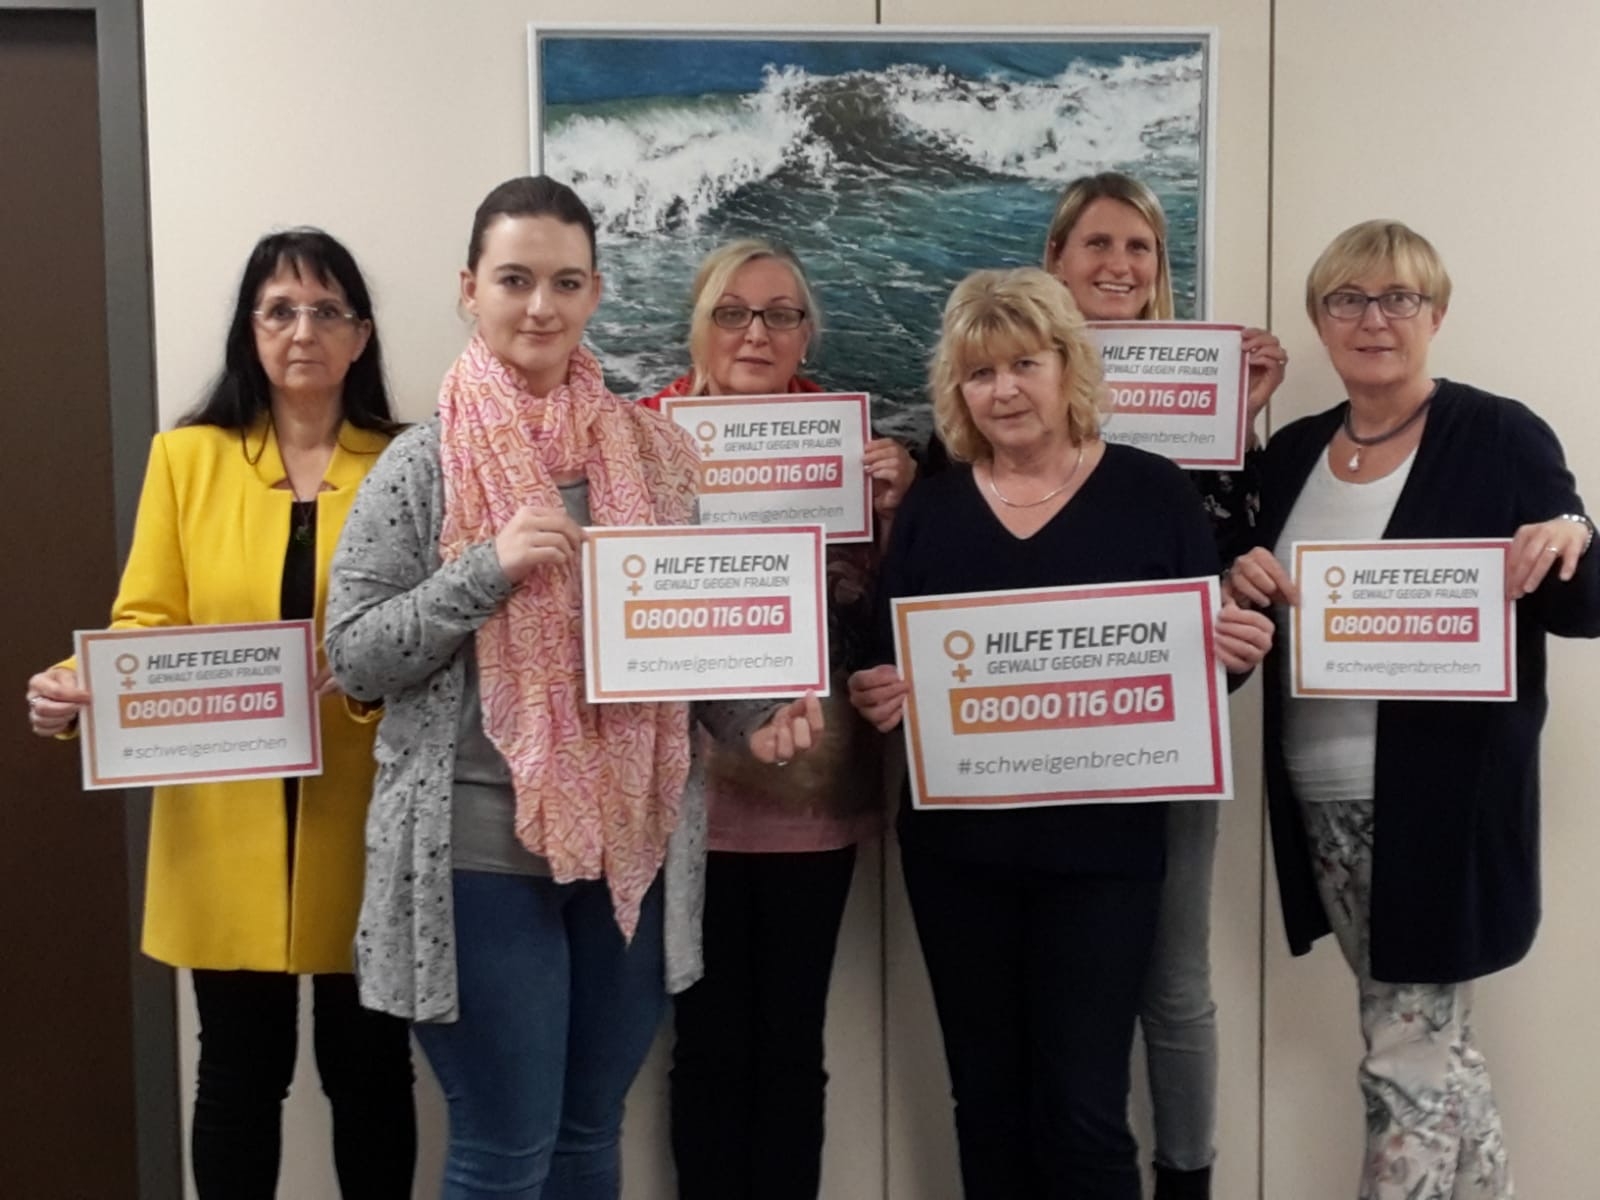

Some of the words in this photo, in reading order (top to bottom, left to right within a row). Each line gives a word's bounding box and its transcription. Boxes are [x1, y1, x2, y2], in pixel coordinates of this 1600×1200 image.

[1102, 346, 1147, 361] HILFE
[1149, 347, 1219, 362] TELEFON
[1143, 364, 1175, 375] GEGEN
[1178, 366, 1218, 376] FRAUEN
[1149, 389, 1175, 407] 116
[1179, 390, 1211, 408] 016
[724, 422, 767, 438] HILFE
[771, 420, 840, 436] TELEFON
[725, 441, 763, 452] GEWALT
[767, 440, 799, 450] GEGEN
[802, 438, 841, 449] FRAUEN
[705, 466, 772, 486] 08000
[776, 465, 802, 483] 116
[806, 463, 837, 482] 016
[701, 505, 843, 523] #schweigenbrechen
[654, 556, 705, 574] HILFE
[709, 554, 789, 572] TELEFON
[655, 578, 700, 591] GEWALT
[703, 577, 741, 589] GEGEN
[744, 576, 789, 588] FRAUEN
[1353, 569, 1401, 585] HILFE
[1403, 568, 1479, 584] TELEFON
[1353, 589, 1394, 600] GEWALT
[1396, 589, 1432, 599] GEGEN
[1435, 588, 1478, 599] FRAUEN
[631, 608, 708, 630] 08000
[712, 606, 743, 627] 116
[747, 604, 784, 626] 016
[1330, 615, 1400, 635] 08000
[1404, 615, 1433, 634] 116
[1437, 615, 1473, 634] 016
[986, 630, 1053, 655] HILFE
[1058, 621, 1167, 650] TELEFON
[147, 652, 198, 670] HILFE
[201, 647, 280, 666] TELEFON
[627, 653, 793, 673] #schweigenbrechen
[987, 658, 1046, 675] GEWALT
[1051, 654, 1102, 670] GEGEN
[1107, 649, 1170, 667] FRAUEN
[1325, 659, 1481, 676] #schweigenbrechen
[148, 672, 192, 684] GEWALT
[196, 669, 232, 681] GEGEN
[236, 666, 281, 677] FRAUEN
[126, 697, 200, 720] 08000
[206, 693, 236, 714] 116
[240, 691, 277, 712] 016
[960, 693, 1061, 724] 08000
[1066, 690, 1108, 718] 116
[1113, 686, 1164, 715] 016
[123, 737, 287, 759] #schweigenbrechen
[957, 747, 1179, 775] #schweigenbrechen
